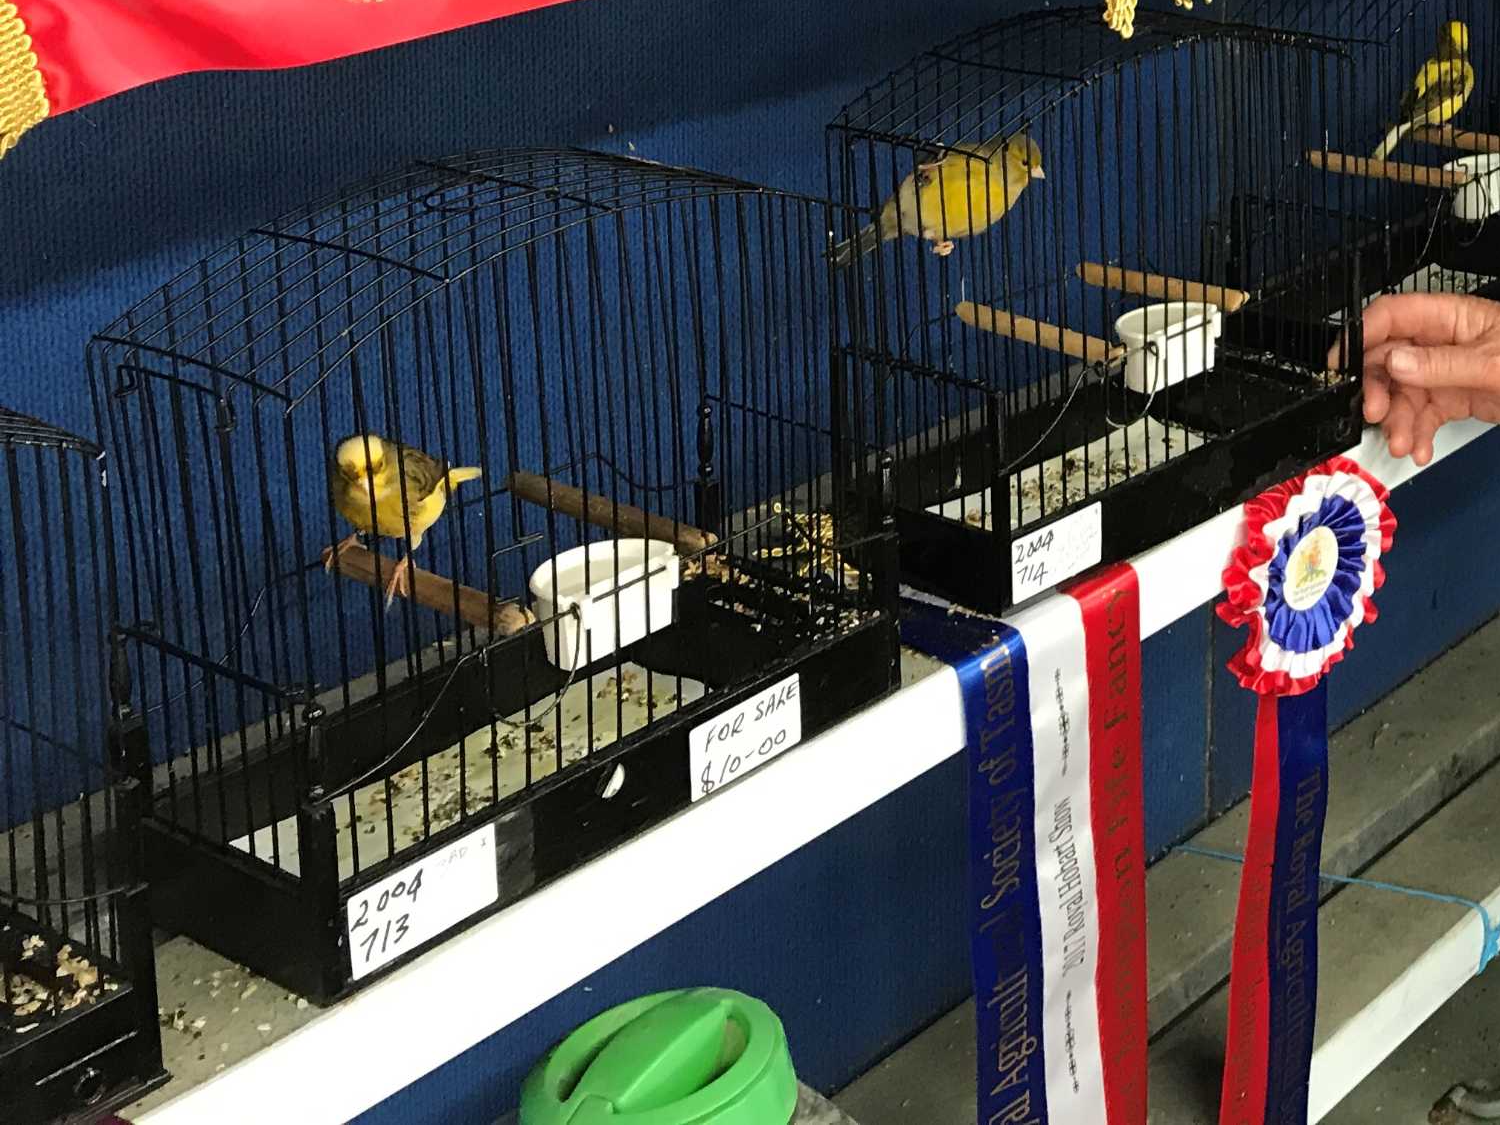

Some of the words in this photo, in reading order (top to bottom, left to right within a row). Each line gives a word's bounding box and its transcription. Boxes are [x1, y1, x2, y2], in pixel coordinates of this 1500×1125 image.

[1017, 561, 1049, 586] 714
[705, 712, 745, 753] FOR
[753, 679, 799, 722] SALE
[701, 728, 786, 794] $10-00
[977, 743, 1017, 786] of
[1047, 795, 1073, 843] Show
[1295, 764, 1322, 828] The
[981, 786, 1028, 909] Society
[1052, 835, 1083, 899] Hobart
[1283, 828, 1317, 915] Royal
[351, 868, 424, 933] 2004
[1058, 888, 1088, 943] Royal
[360, 913, 411, 963] 713
[1061, 935, 1086, 977] 2017
[980, 904, 1038, 1095] Agricultl
